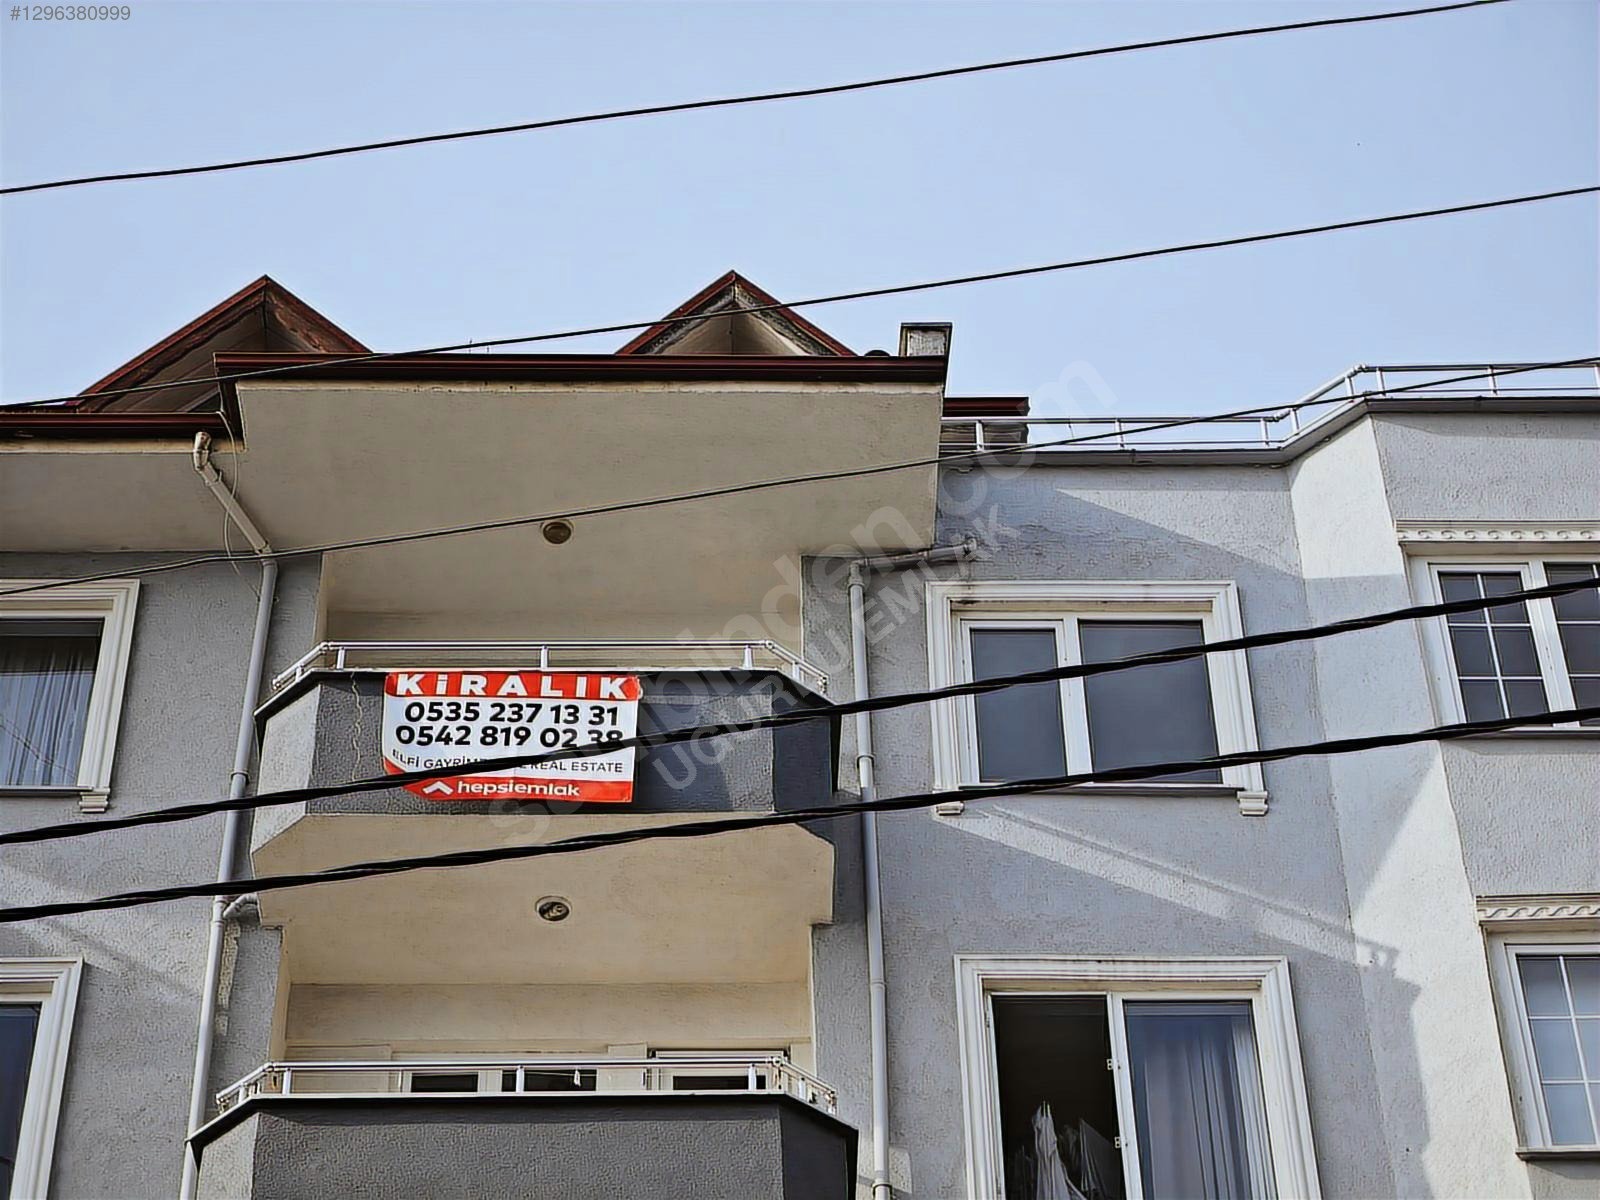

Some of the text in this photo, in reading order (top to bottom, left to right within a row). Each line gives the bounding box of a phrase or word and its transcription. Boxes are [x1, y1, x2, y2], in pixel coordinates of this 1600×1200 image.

[404, 701, 618, 726] 0535 237 13 31
[395, 725, 471, 746] 0542
[479, 726, 532, 747] 819
[539, 727, 578, 748] 02
[571, 761, 623, 773] ESTATE
[457, 780, 580, 796] hepsiemlak
